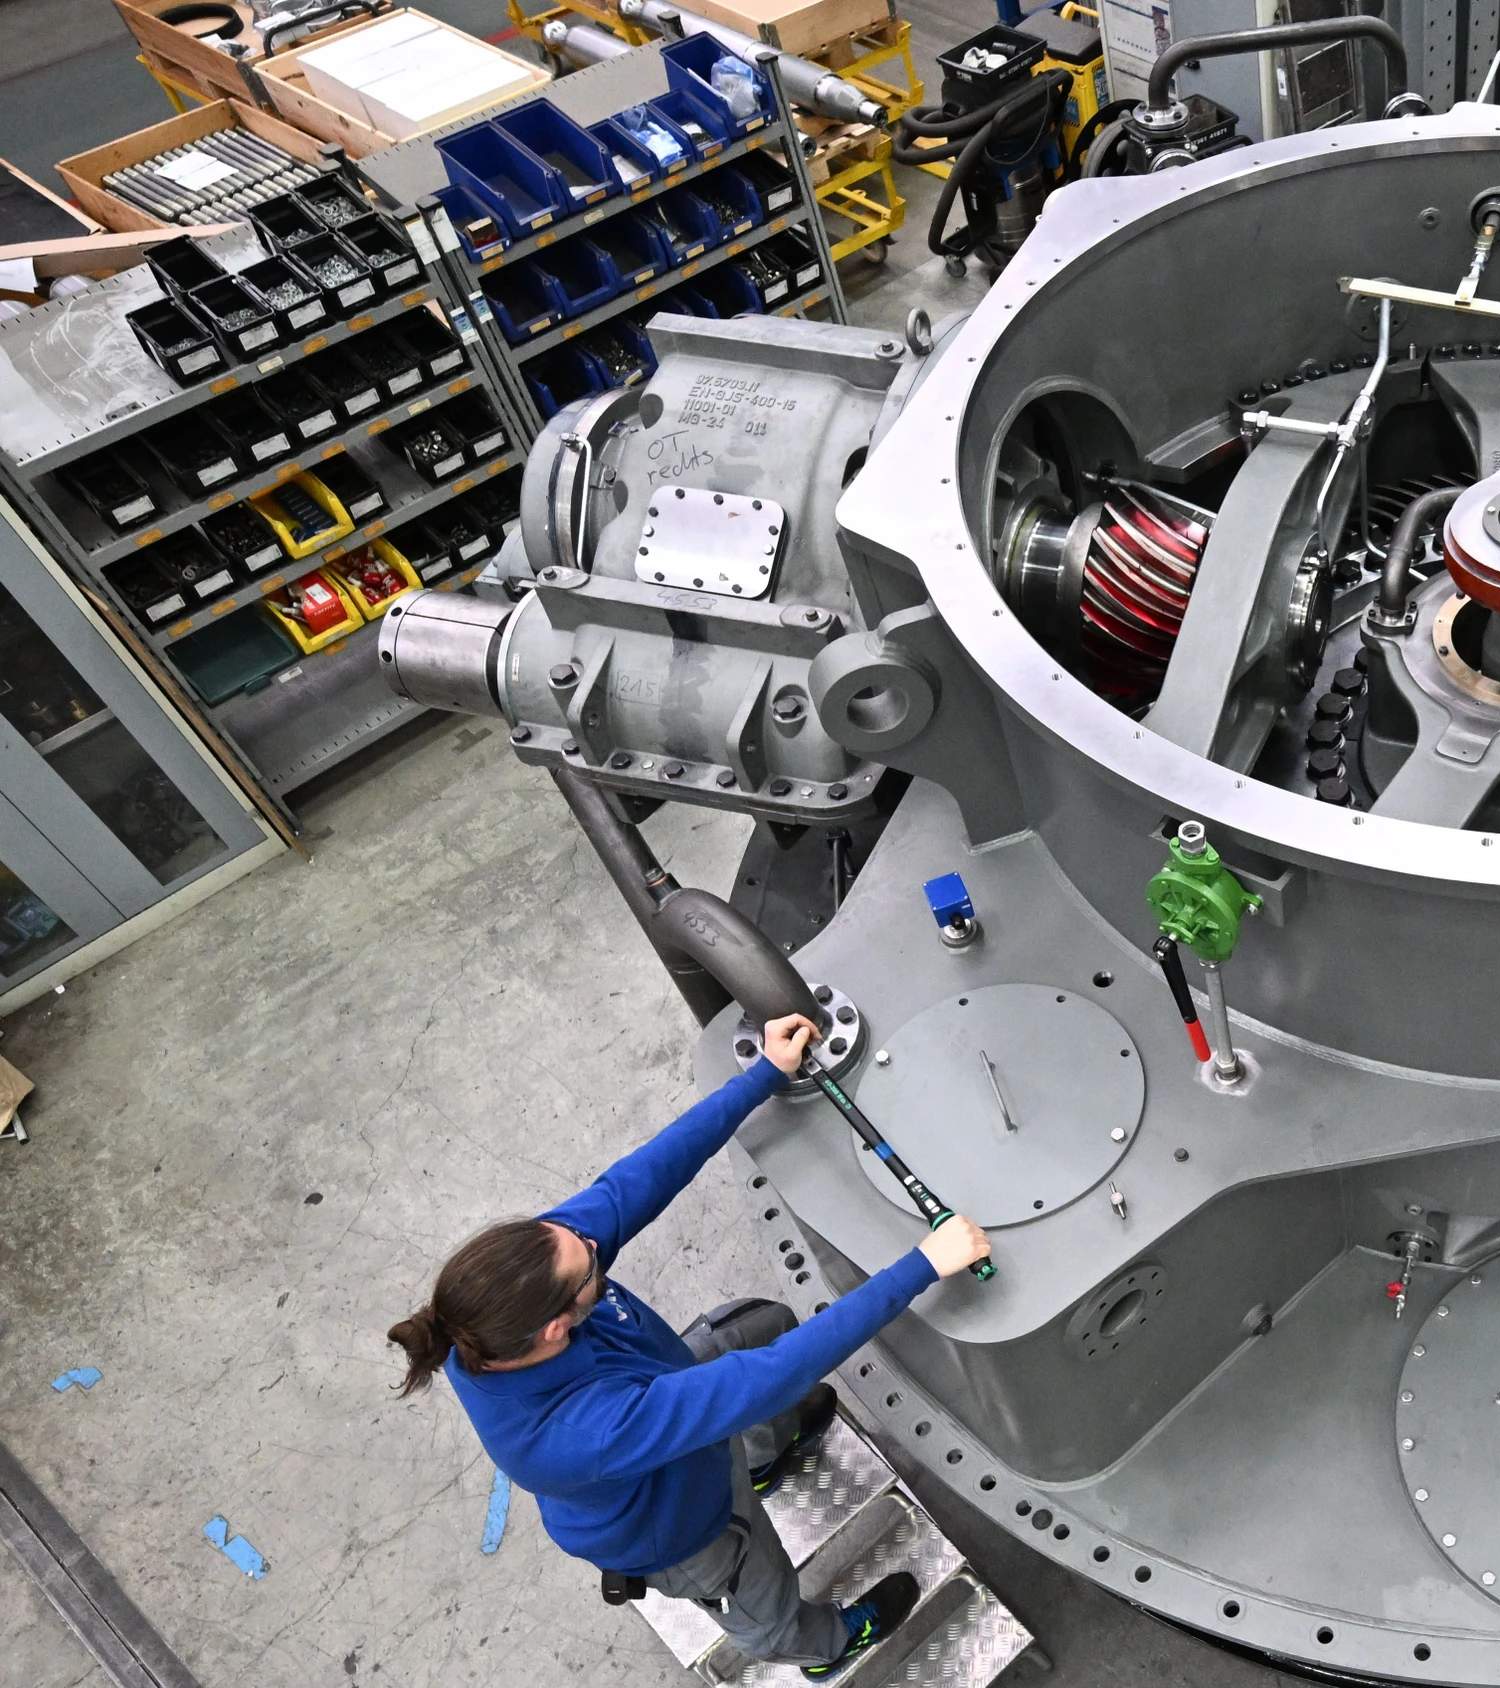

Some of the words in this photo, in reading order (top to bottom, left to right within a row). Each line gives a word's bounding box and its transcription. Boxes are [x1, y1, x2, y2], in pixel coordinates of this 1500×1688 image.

[647, 429, 690, 460] OT
[647, 444, 714, 486] rechts
[620, 674, 657, 698] 215
